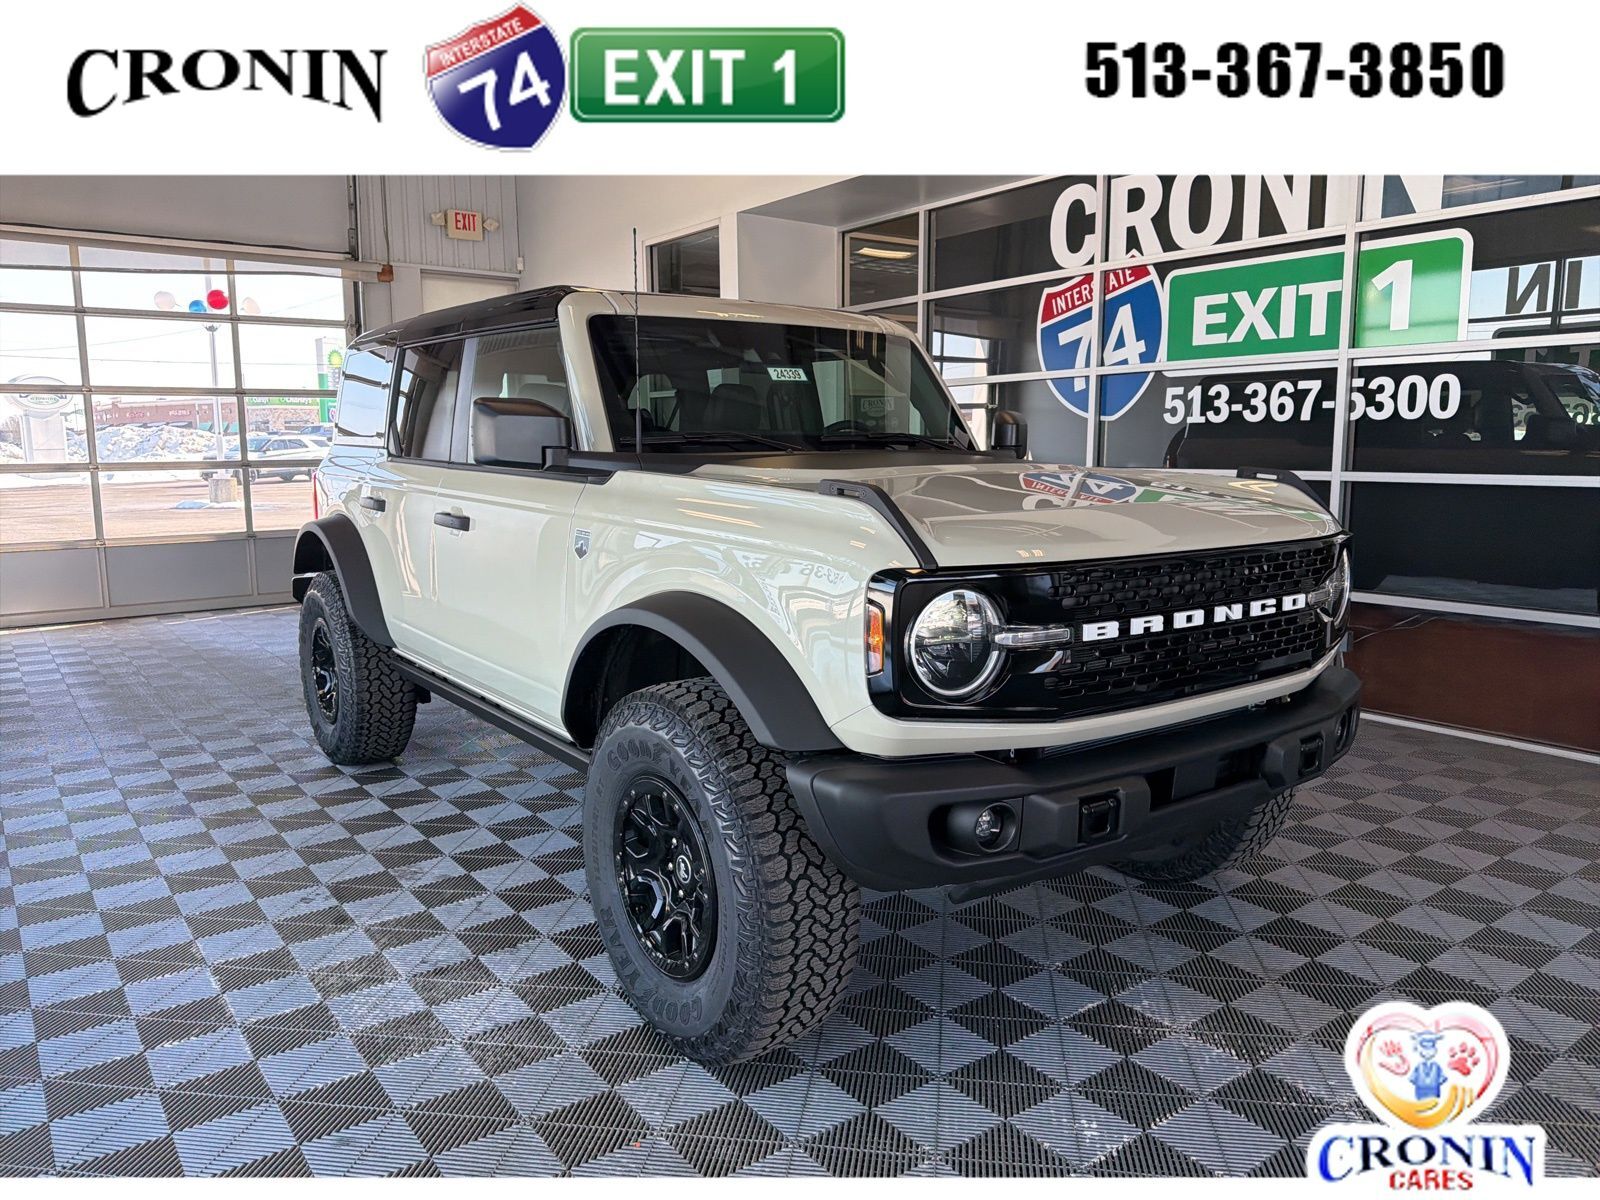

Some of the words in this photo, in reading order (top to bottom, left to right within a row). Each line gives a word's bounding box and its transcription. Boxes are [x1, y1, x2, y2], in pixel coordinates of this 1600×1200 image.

[455, 211, 477, 232] EXIT
[1192, 279, 1343, 347] EXIT
[1370, 259, 1413, 331] 1
[1057, 303, 1147, 393] 74
[773, 368, 802, 380] 24339
[1162, 373, 1462, 425] 513-367-5300
[1082, 593, 1306, 642] BRONCO
